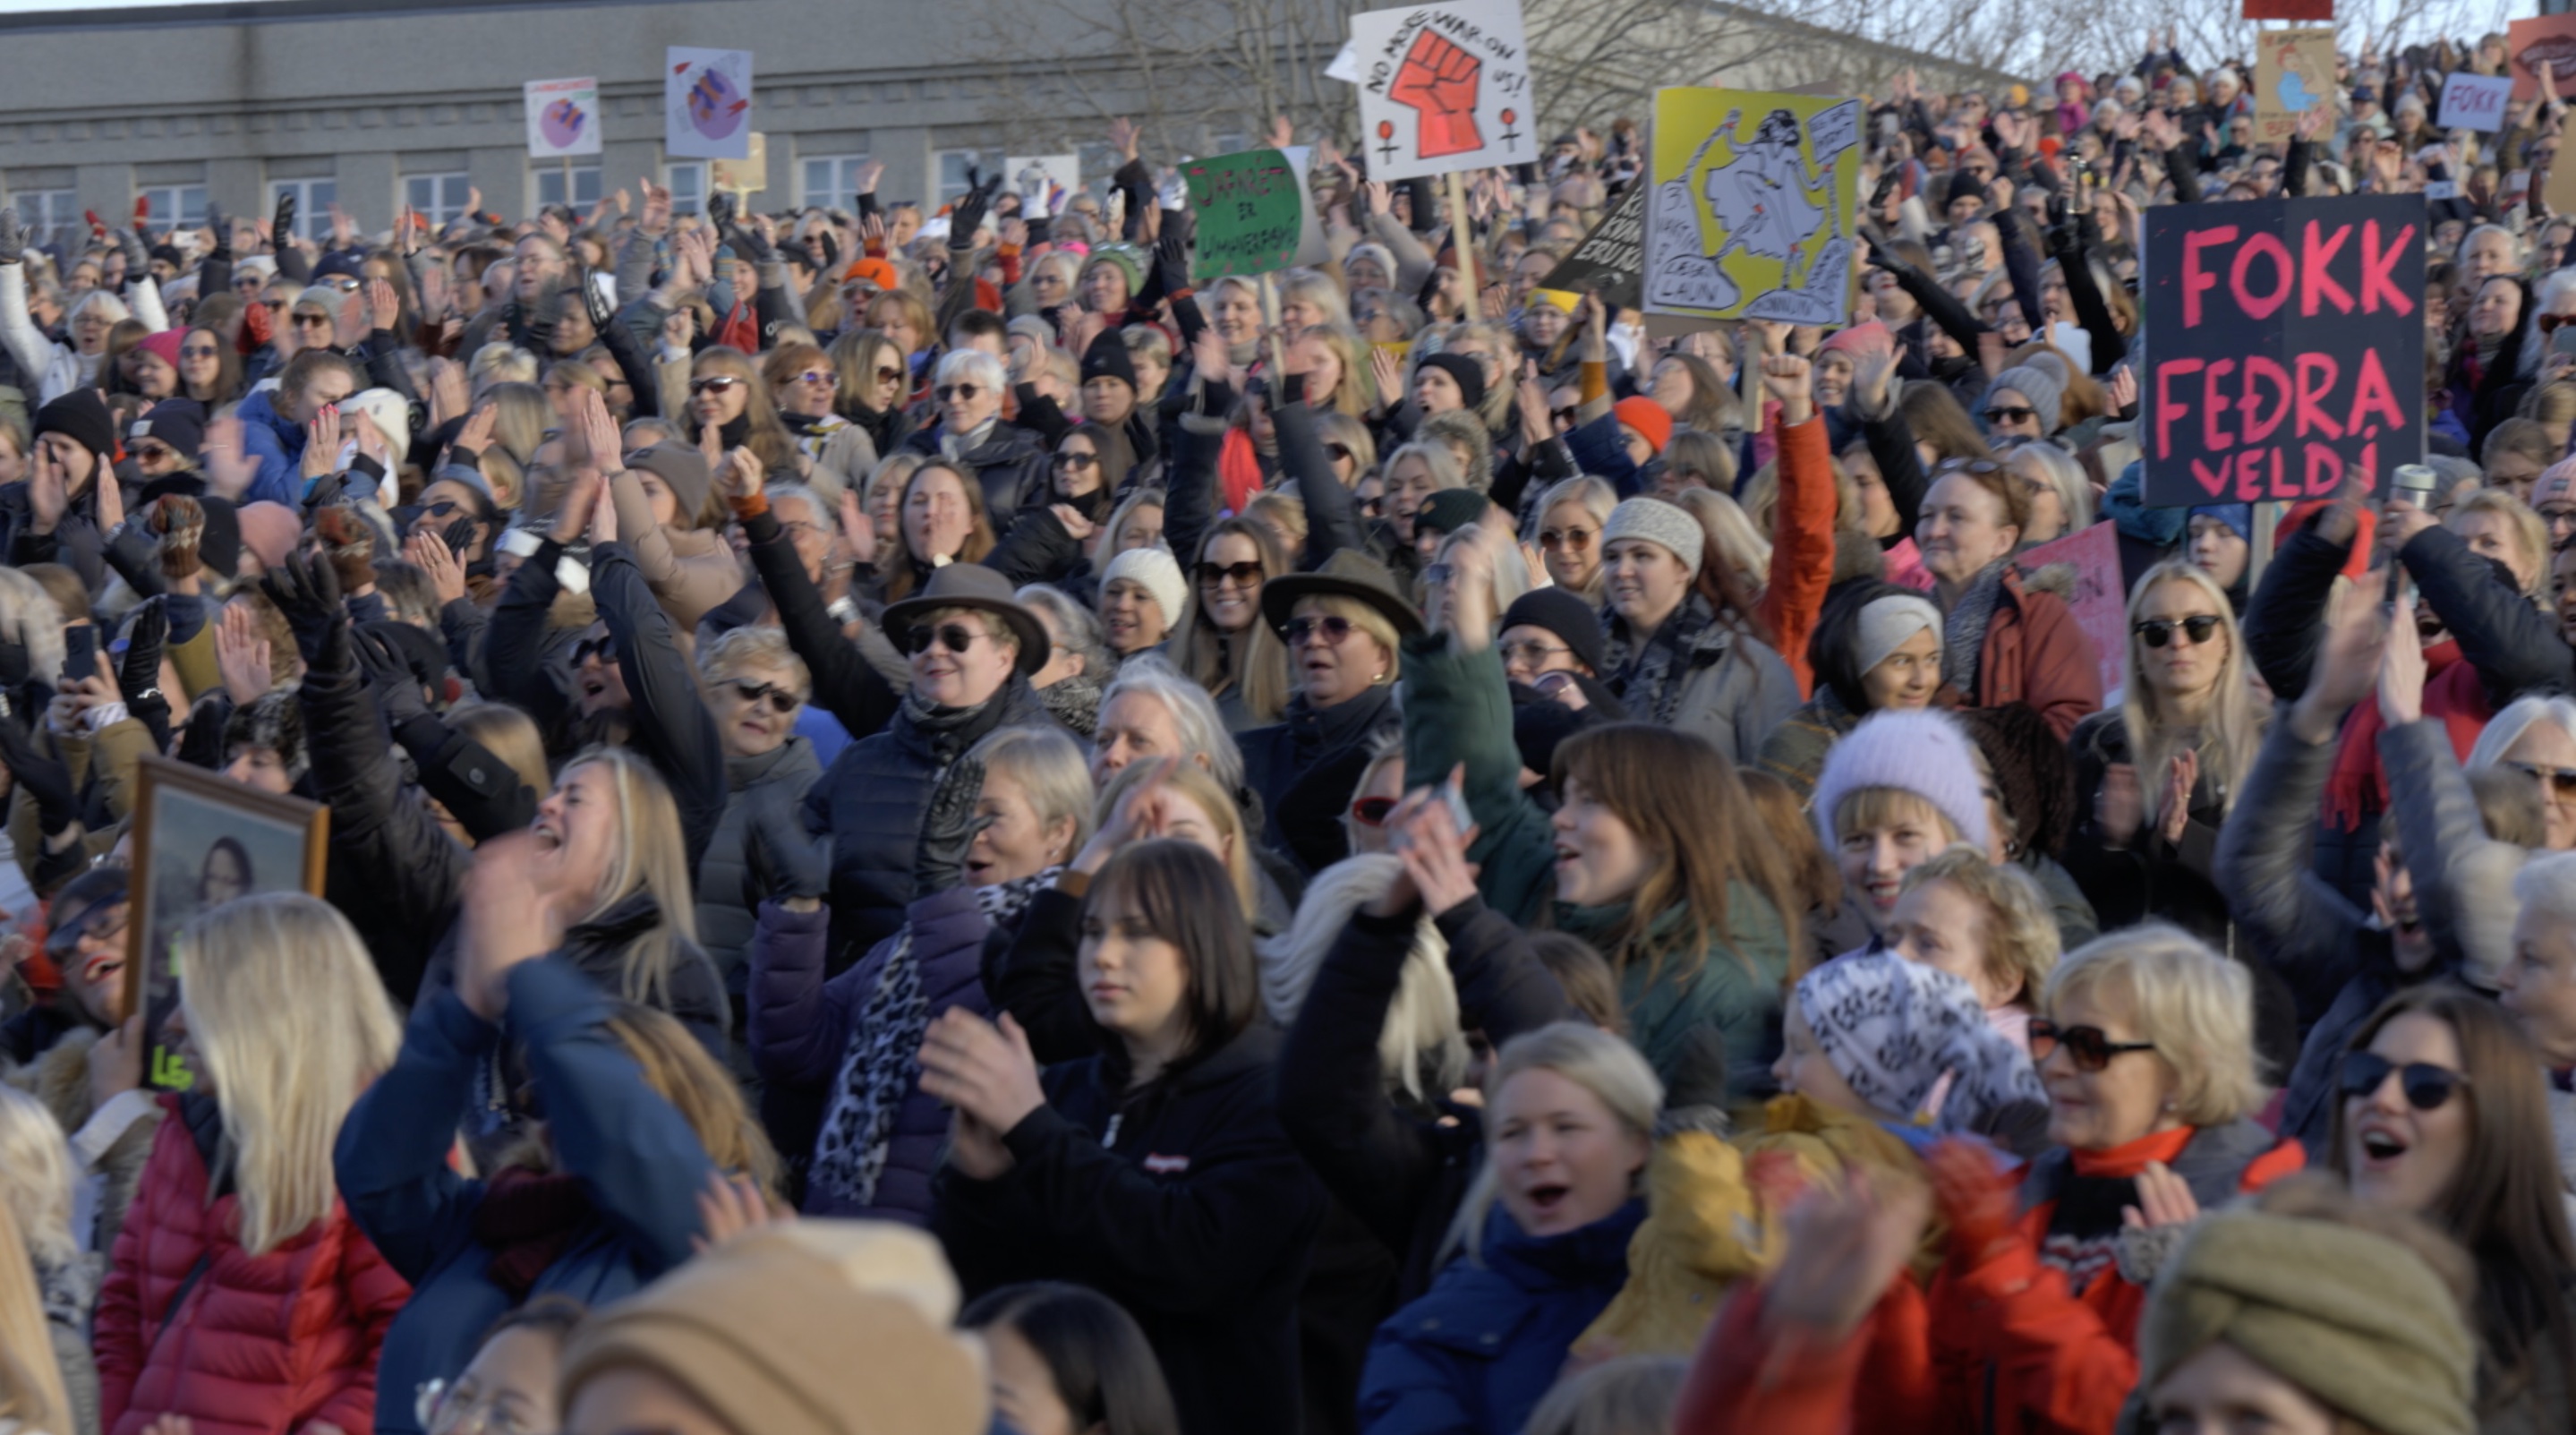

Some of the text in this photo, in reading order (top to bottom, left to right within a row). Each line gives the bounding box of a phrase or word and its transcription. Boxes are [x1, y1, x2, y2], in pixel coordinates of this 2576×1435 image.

[1366, 9, 1518, 94] NO MORE WAR ON
[1491, 69, 1527, 98] US!
[2445, 84, 2503, 114] FOKK
[1573, 238, 1627, 266] ERU
[2181, 218, 2417, 330] FOKK
[2155, 346, 2407, 462] FEÐRA
